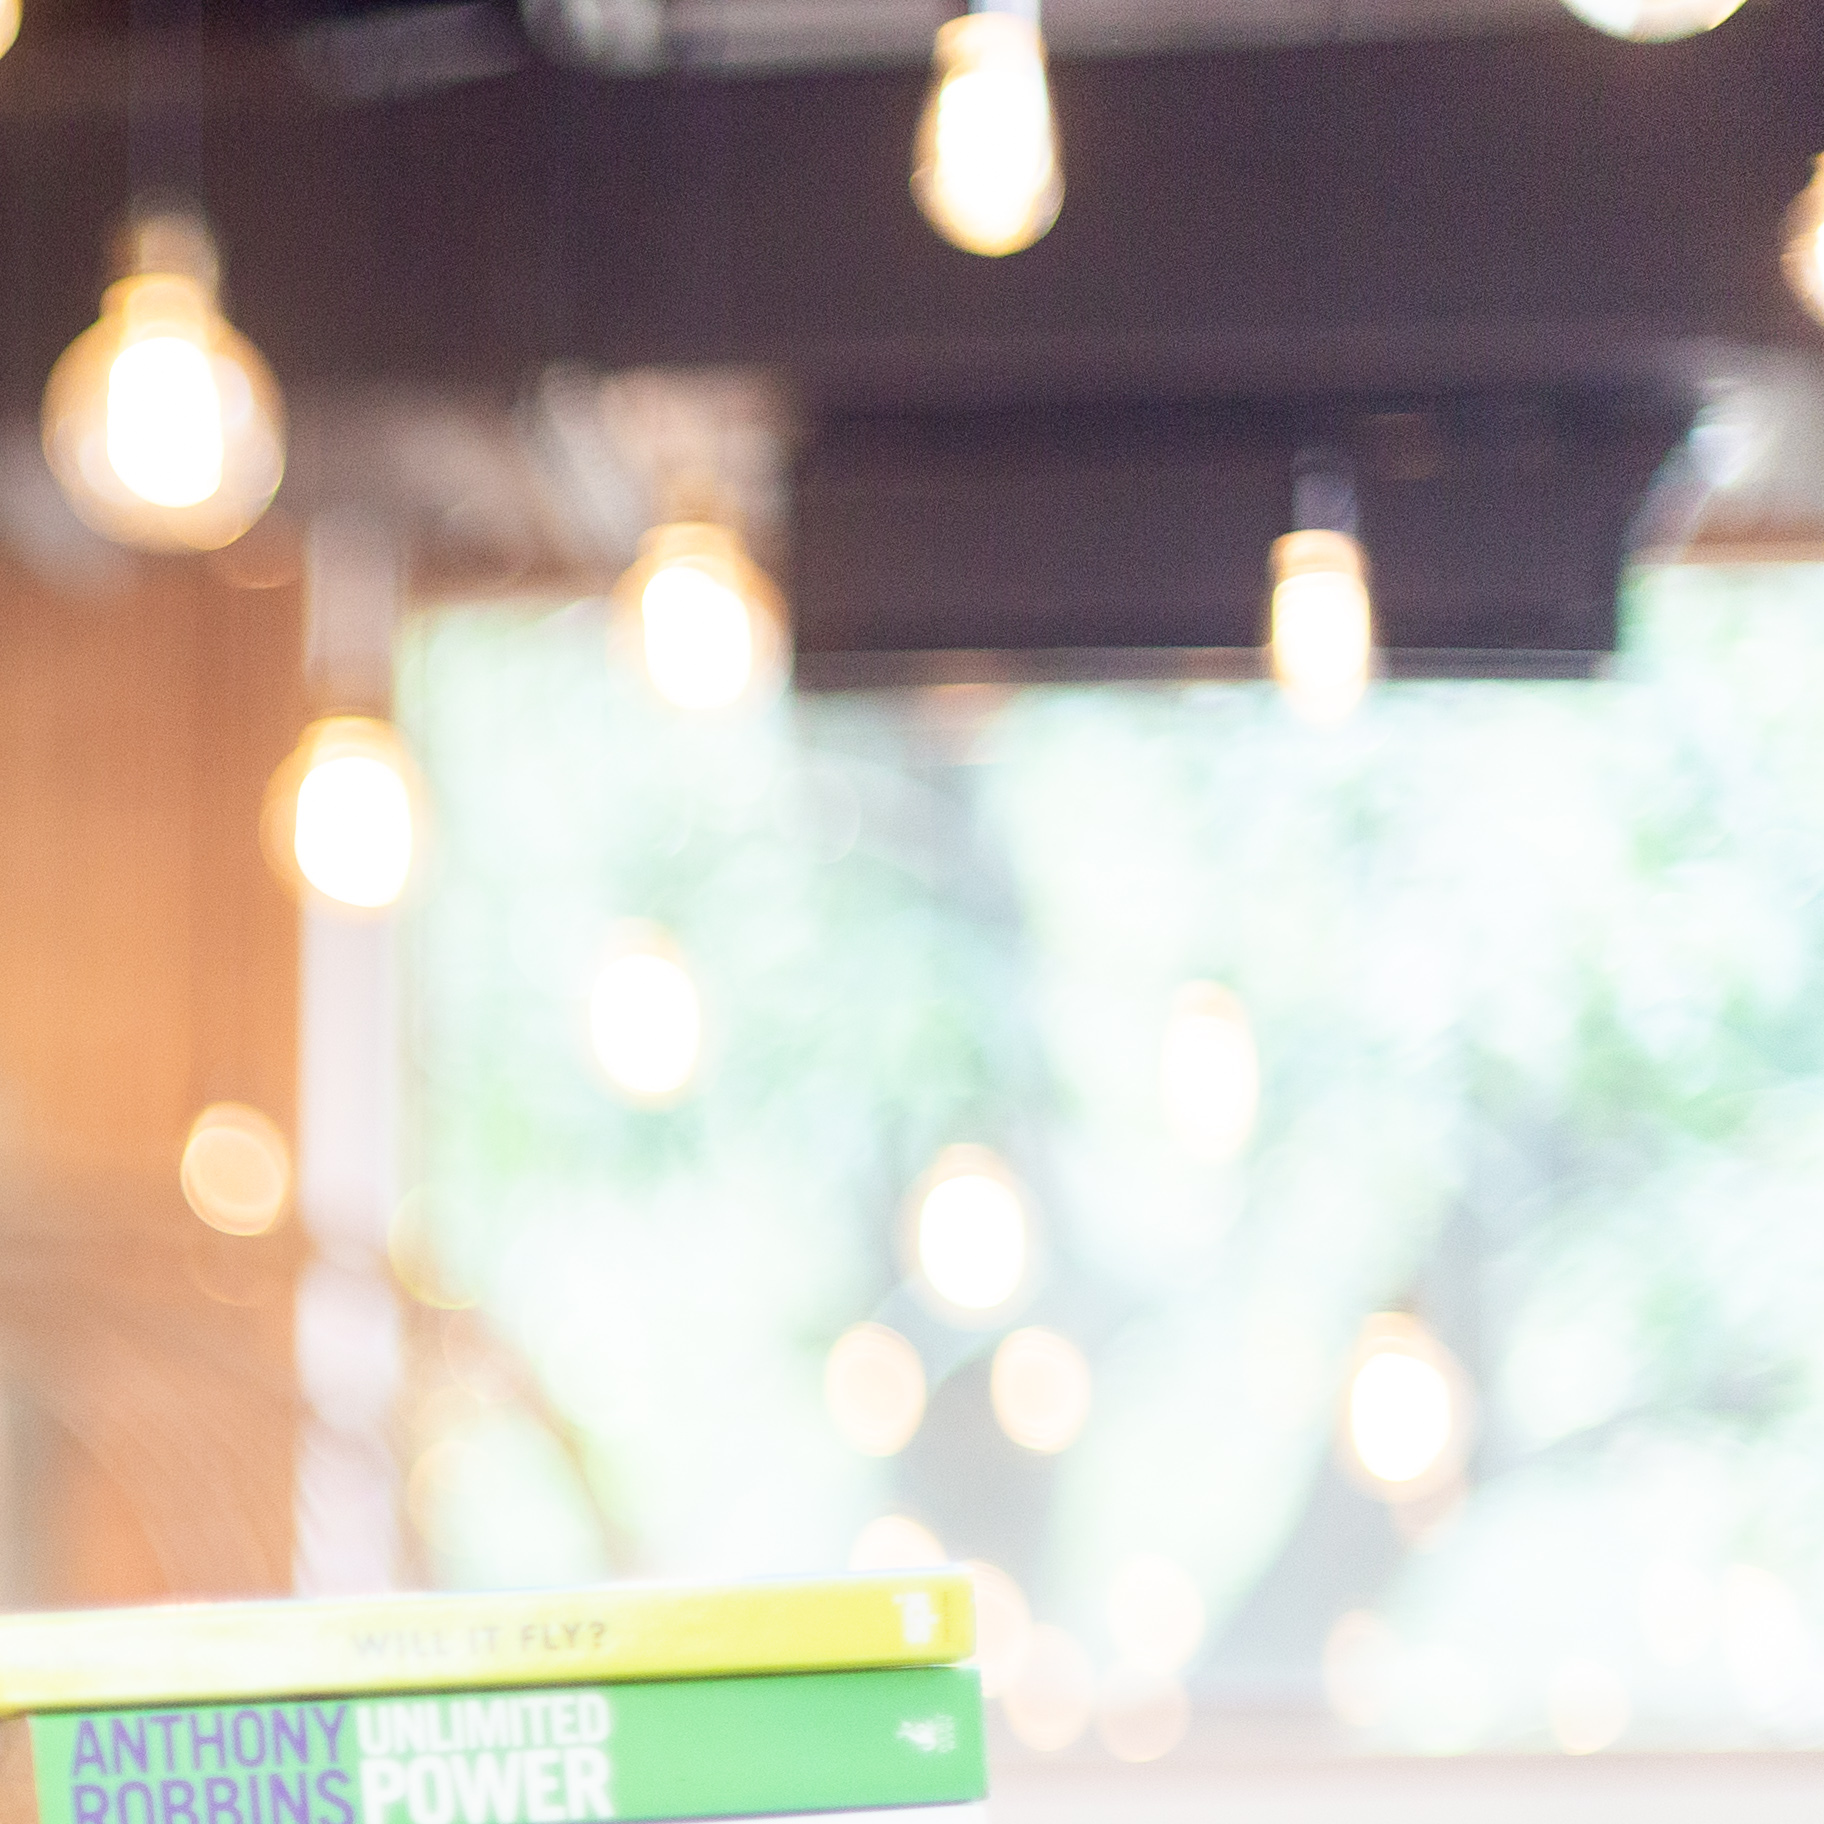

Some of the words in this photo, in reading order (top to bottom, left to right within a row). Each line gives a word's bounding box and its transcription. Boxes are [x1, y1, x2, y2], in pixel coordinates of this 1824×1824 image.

[352, 1628, 448, 1659] WILL
[468, 1625, 499, 1655] IT
[519, 1620, 608, 1652] FLY?
[69, 1705, 348, 1778] ANTHONY
[355, 1692, 614, 1757] UNLIMITED
